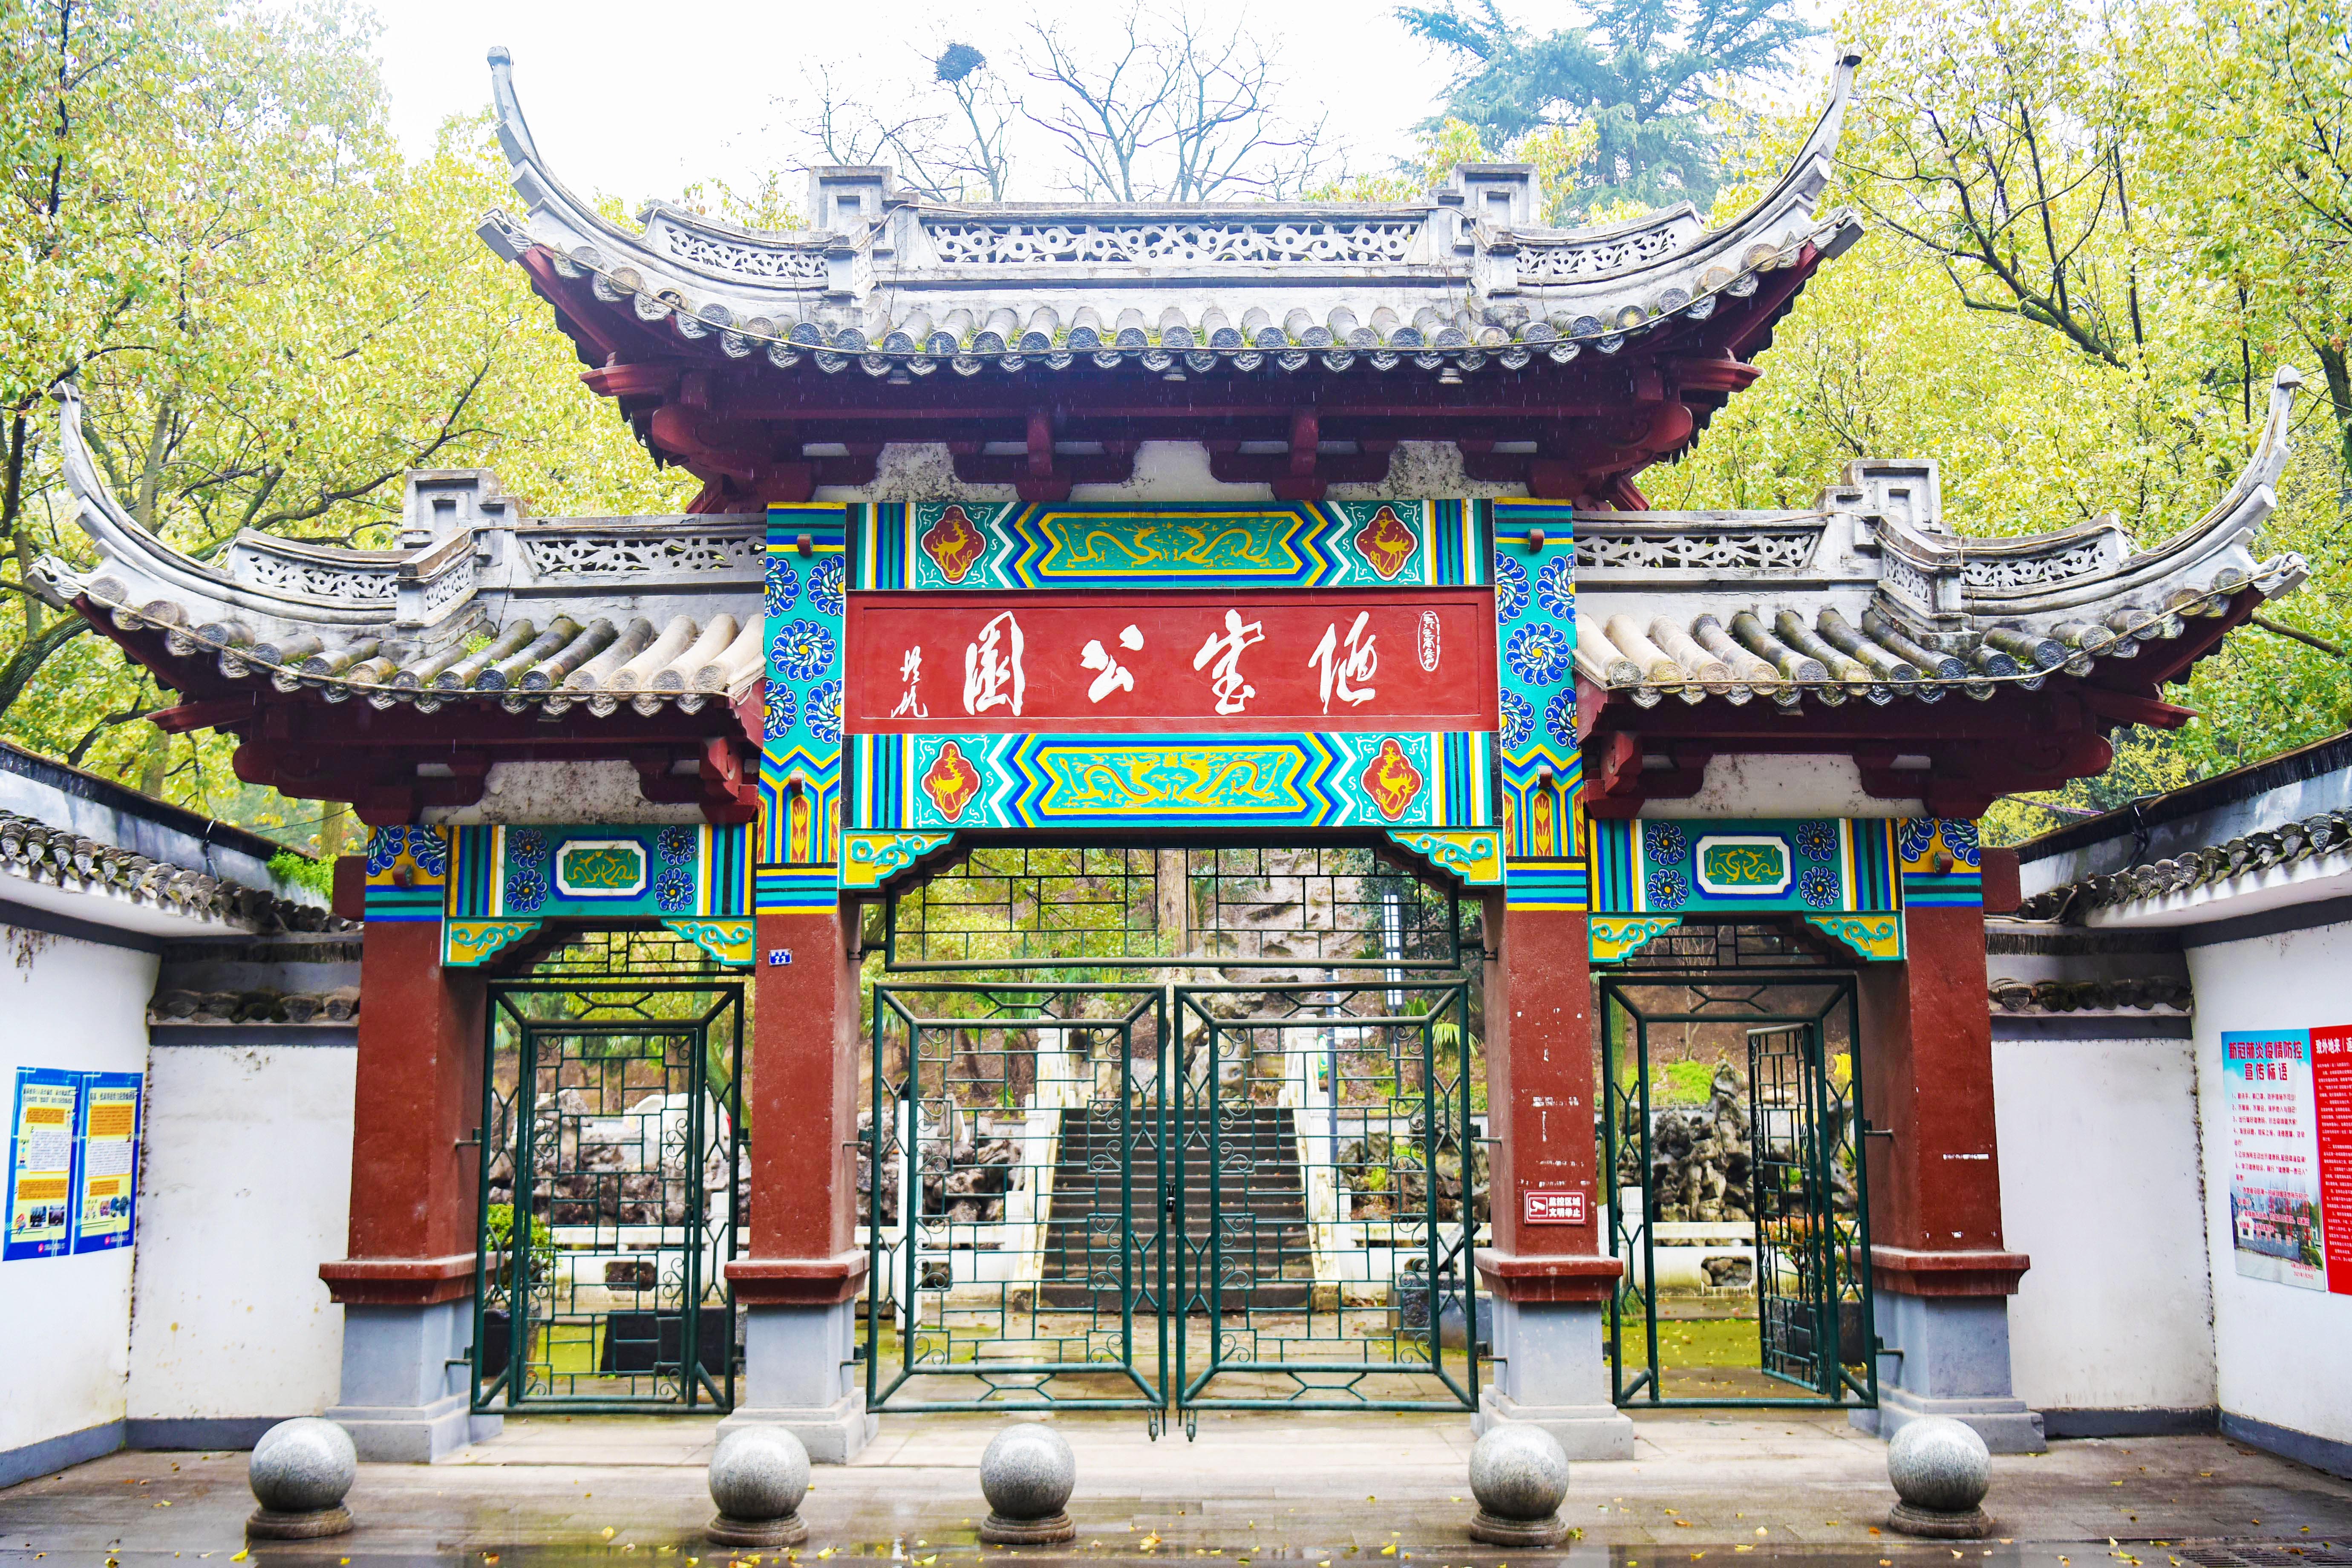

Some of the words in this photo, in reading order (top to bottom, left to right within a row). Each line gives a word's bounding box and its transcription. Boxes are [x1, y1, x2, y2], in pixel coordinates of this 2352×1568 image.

[2229, 1041, 2303, 1059] 新冠肺炎疫情防控
[2245, 1063, 2287, 1080] 宣传标语
[1548, 1196, 1581, 1206] 监控区域
[1549, 1208, 1581, 1217] 文明举止
